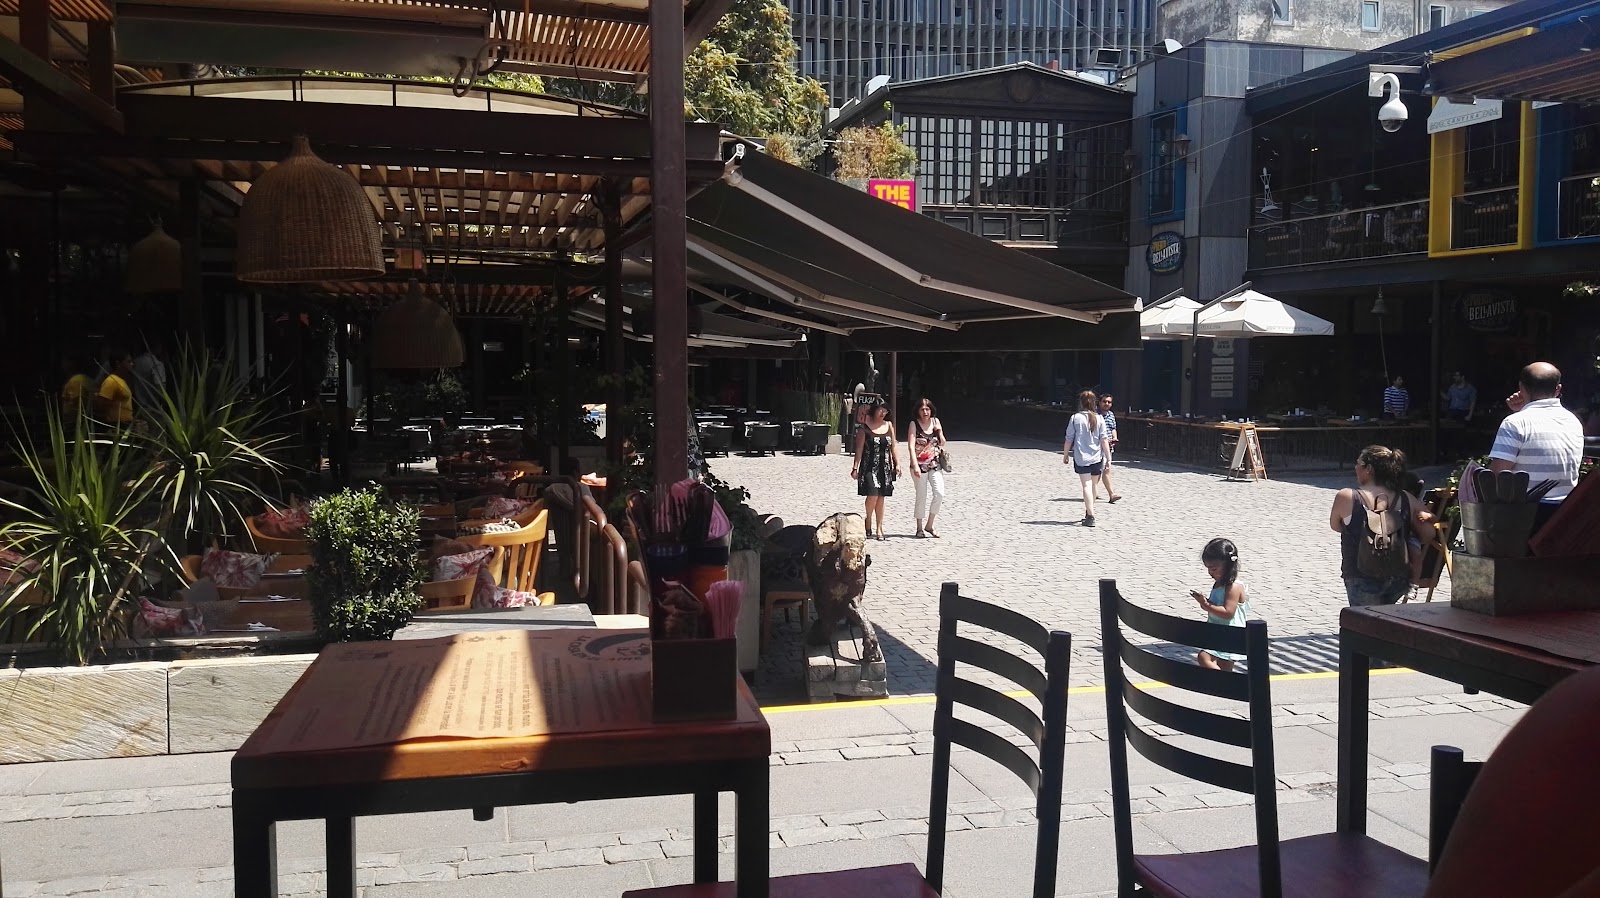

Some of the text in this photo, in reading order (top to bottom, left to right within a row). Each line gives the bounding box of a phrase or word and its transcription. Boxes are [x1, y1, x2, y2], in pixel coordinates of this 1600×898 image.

[1446, 113, 1480, 124] CANTINA
[874, 184, 910, 200] THE
[1469, 300, 1516, 321] BELLAVISTA
